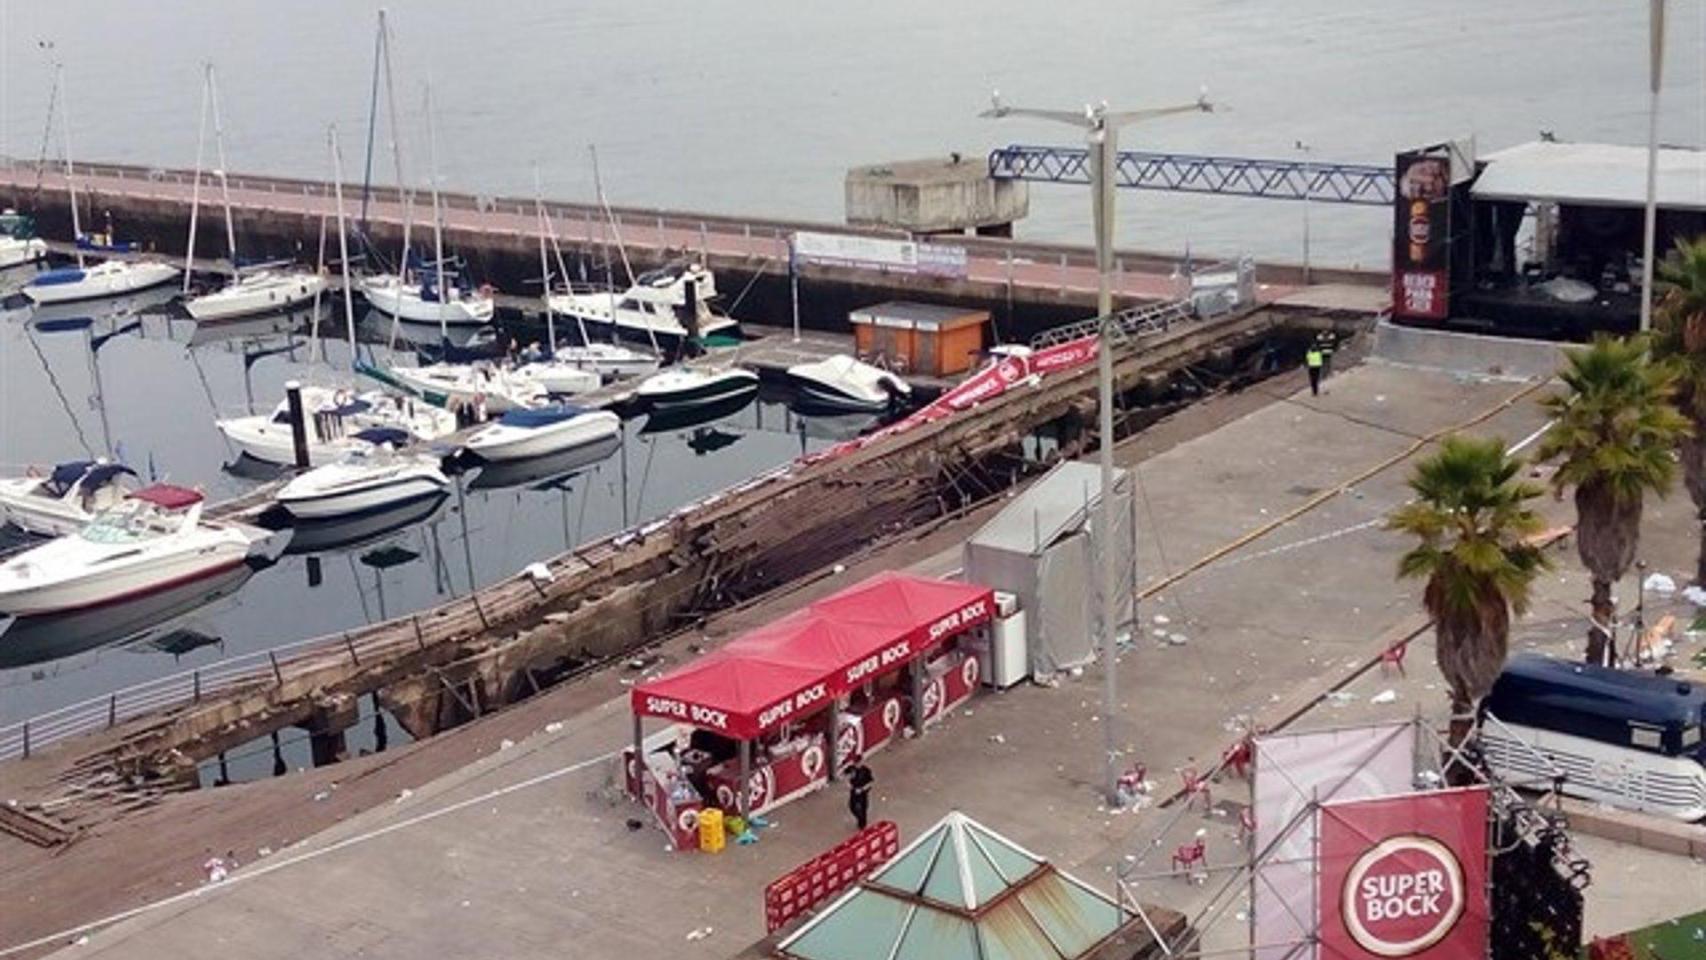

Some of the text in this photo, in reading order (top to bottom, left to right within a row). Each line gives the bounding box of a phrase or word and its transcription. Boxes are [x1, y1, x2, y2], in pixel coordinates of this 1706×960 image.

[929, 600, 987, 640] SUPER BOCK
[847, 640, 910, 683] SUPER BOCK
[646, 696, 728, 728] SUPER BOCK
[759, 683, 827, 728] SUPER BOCK
[1362, 869, 1444, 899] SUPER
[1367, 894, 1440, 921] BOCK
